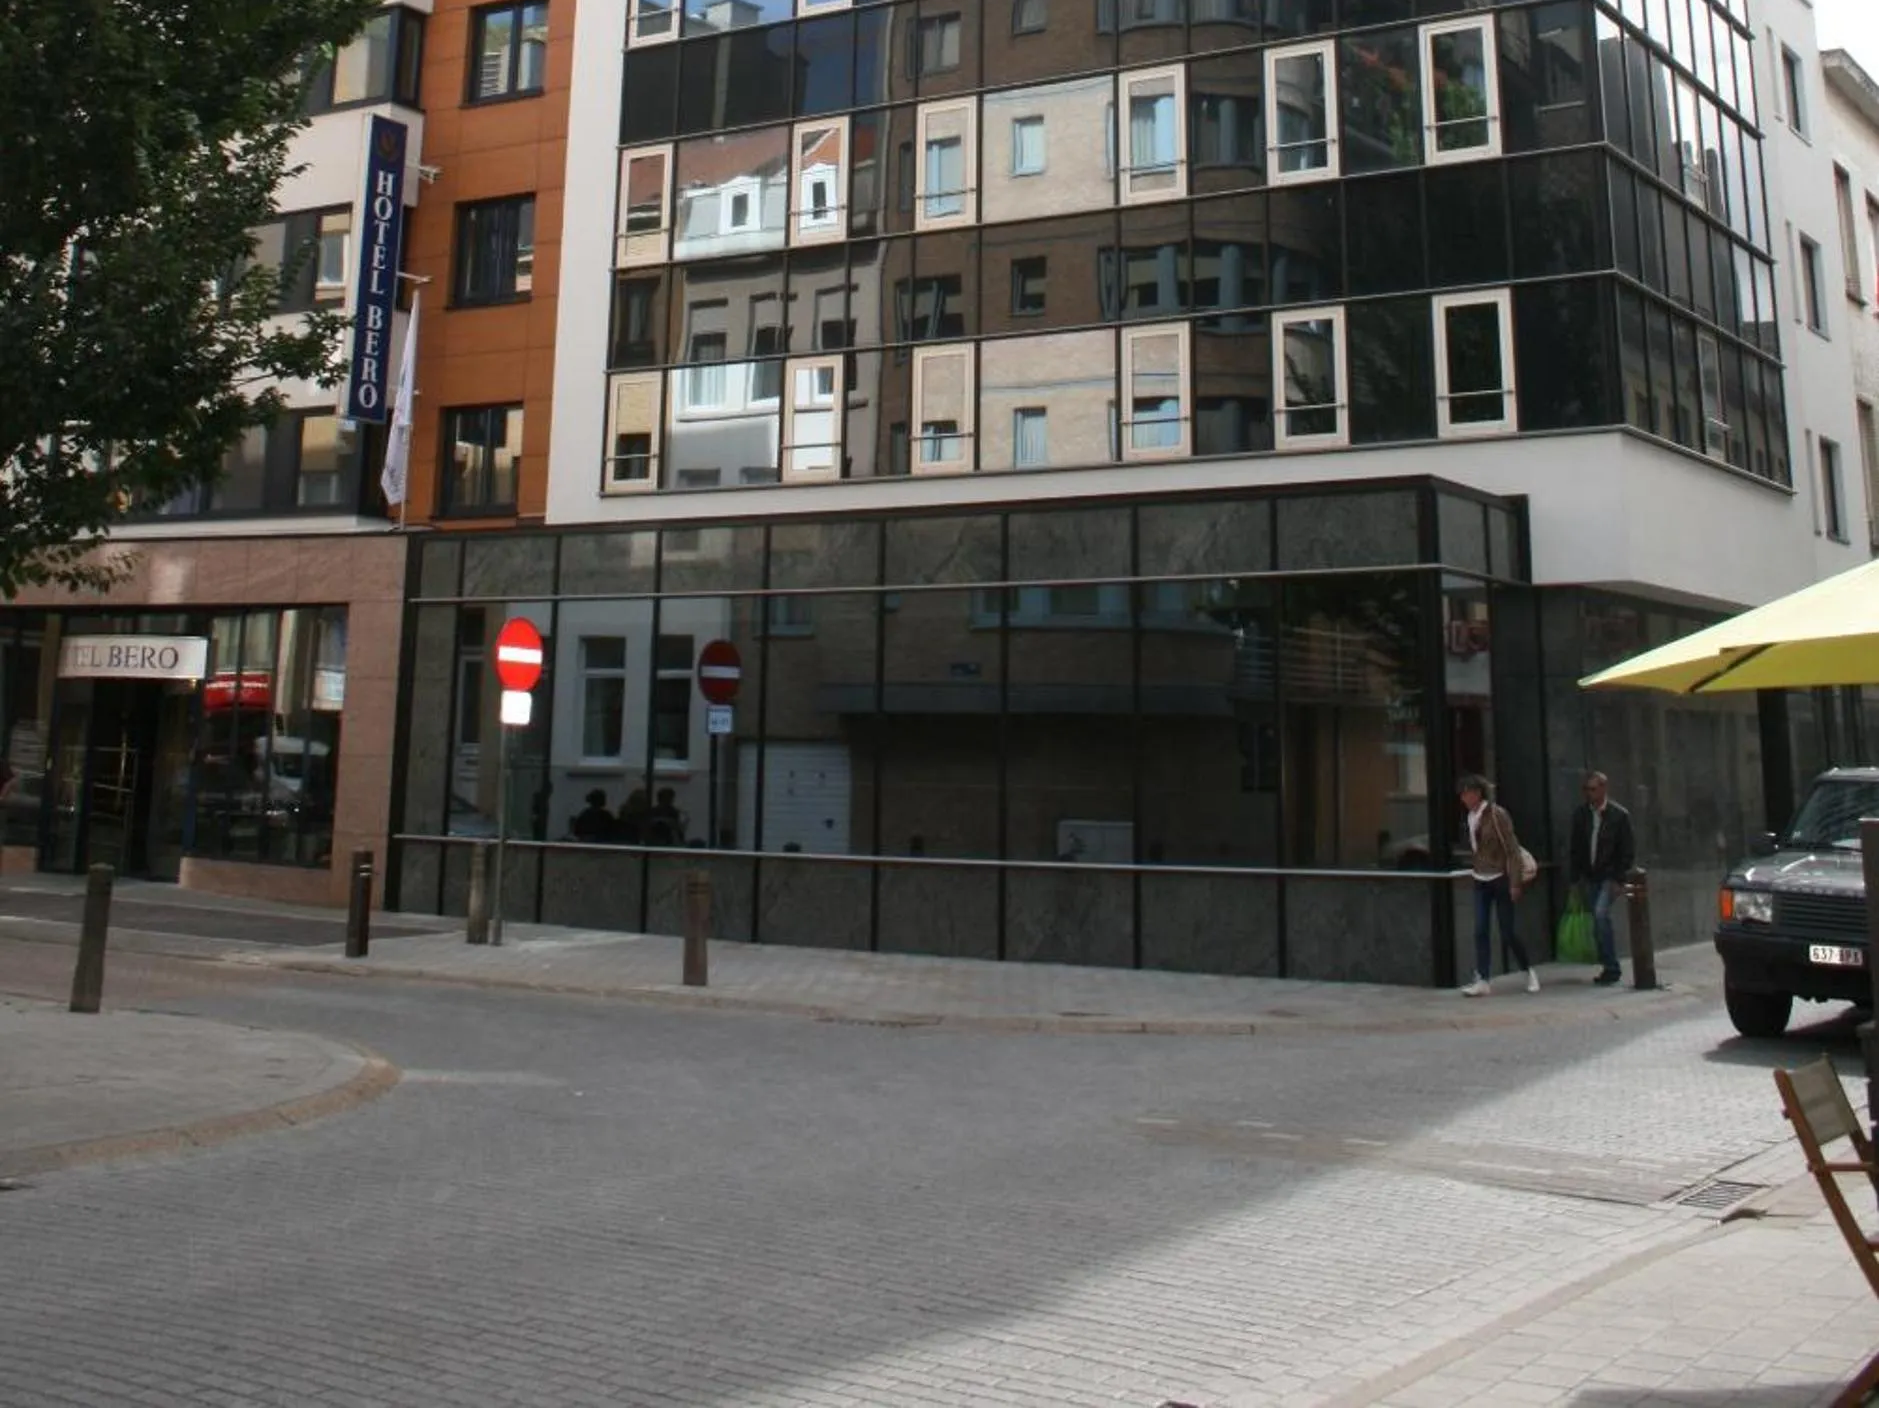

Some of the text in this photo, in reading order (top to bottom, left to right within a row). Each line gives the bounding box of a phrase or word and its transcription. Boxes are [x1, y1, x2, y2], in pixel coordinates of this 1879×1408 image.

[359, 170, 395, 408] HOTEL BERO
[107, 645, 179, 669] BERO
